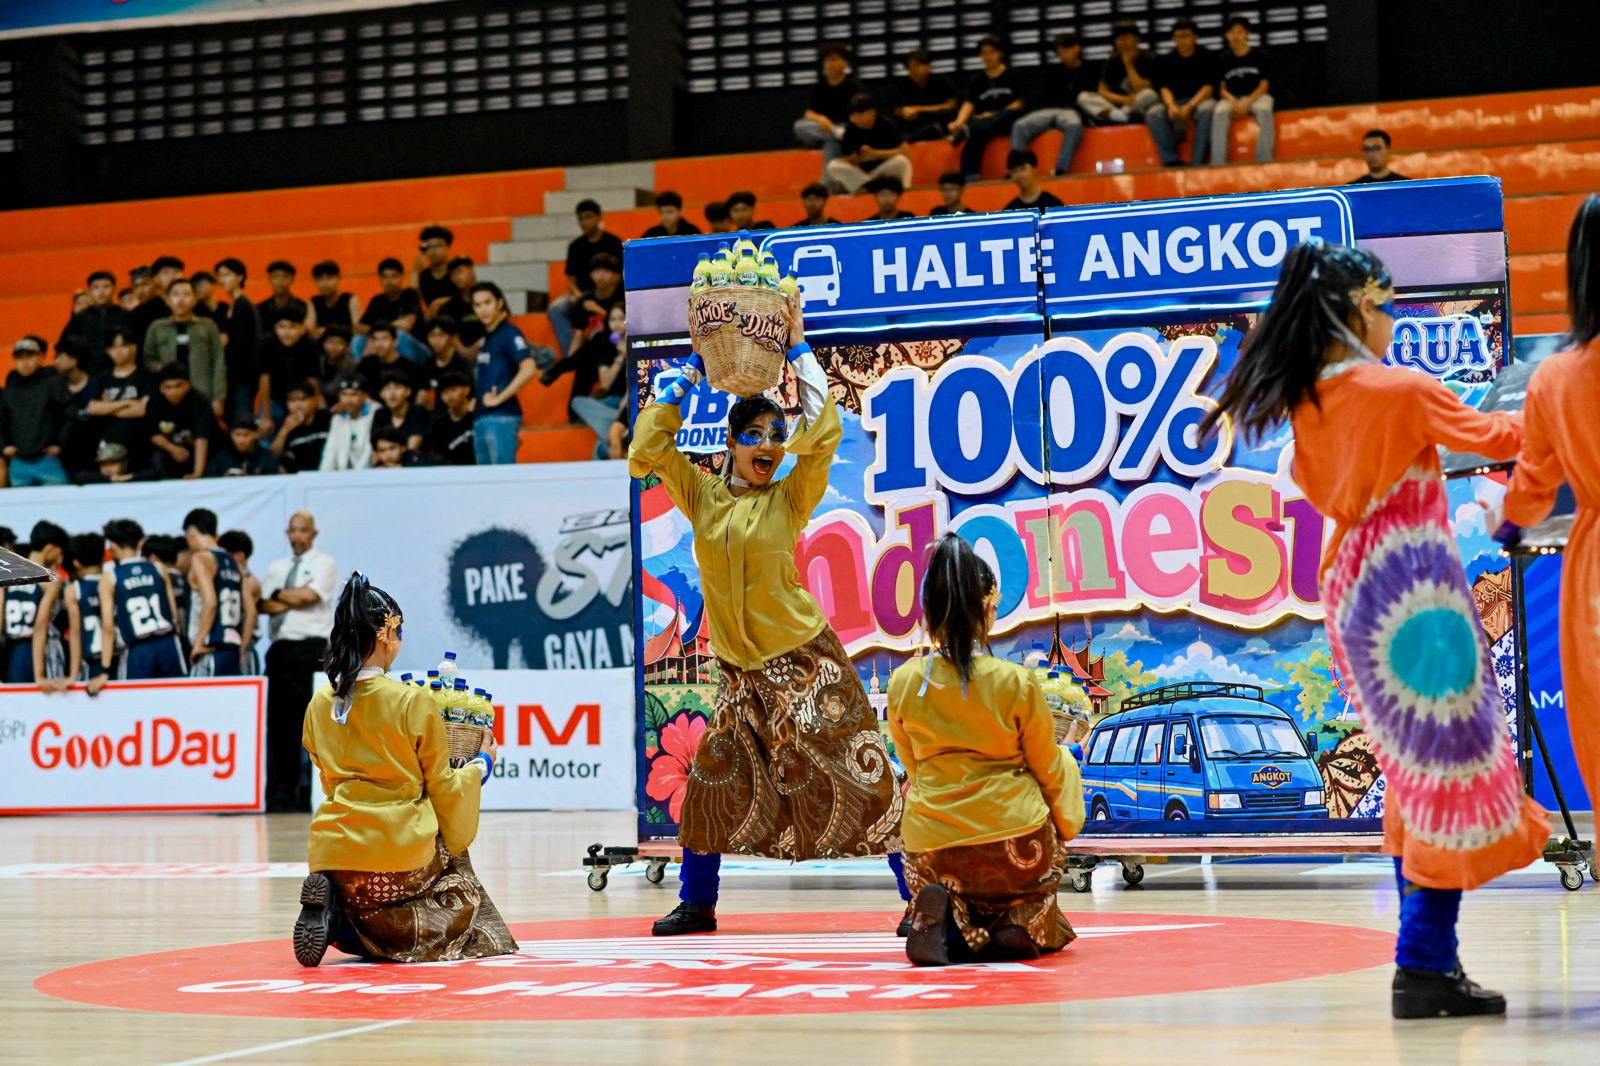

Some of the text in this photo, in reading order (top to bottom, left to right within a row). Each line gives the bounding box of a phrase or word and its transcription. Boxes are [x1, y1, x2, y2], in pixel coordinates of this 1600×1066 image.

[872, 216, 1323, 294] HALTE ANGKOT
[1381, 321, 1487, 376] QUA
[870, 345, 1221, 493] 100%
[464, 562, 528, 606] PAKE
[126, 593, 173, 639] 21
[544, 627, 613, 669] GAYA
[31, 716, 237, 780] Good Day
[529, 758, 602, 778] Motor
[1252, 772, 1291, 784] ANGKOT
[177, 979, 447, 994] One
